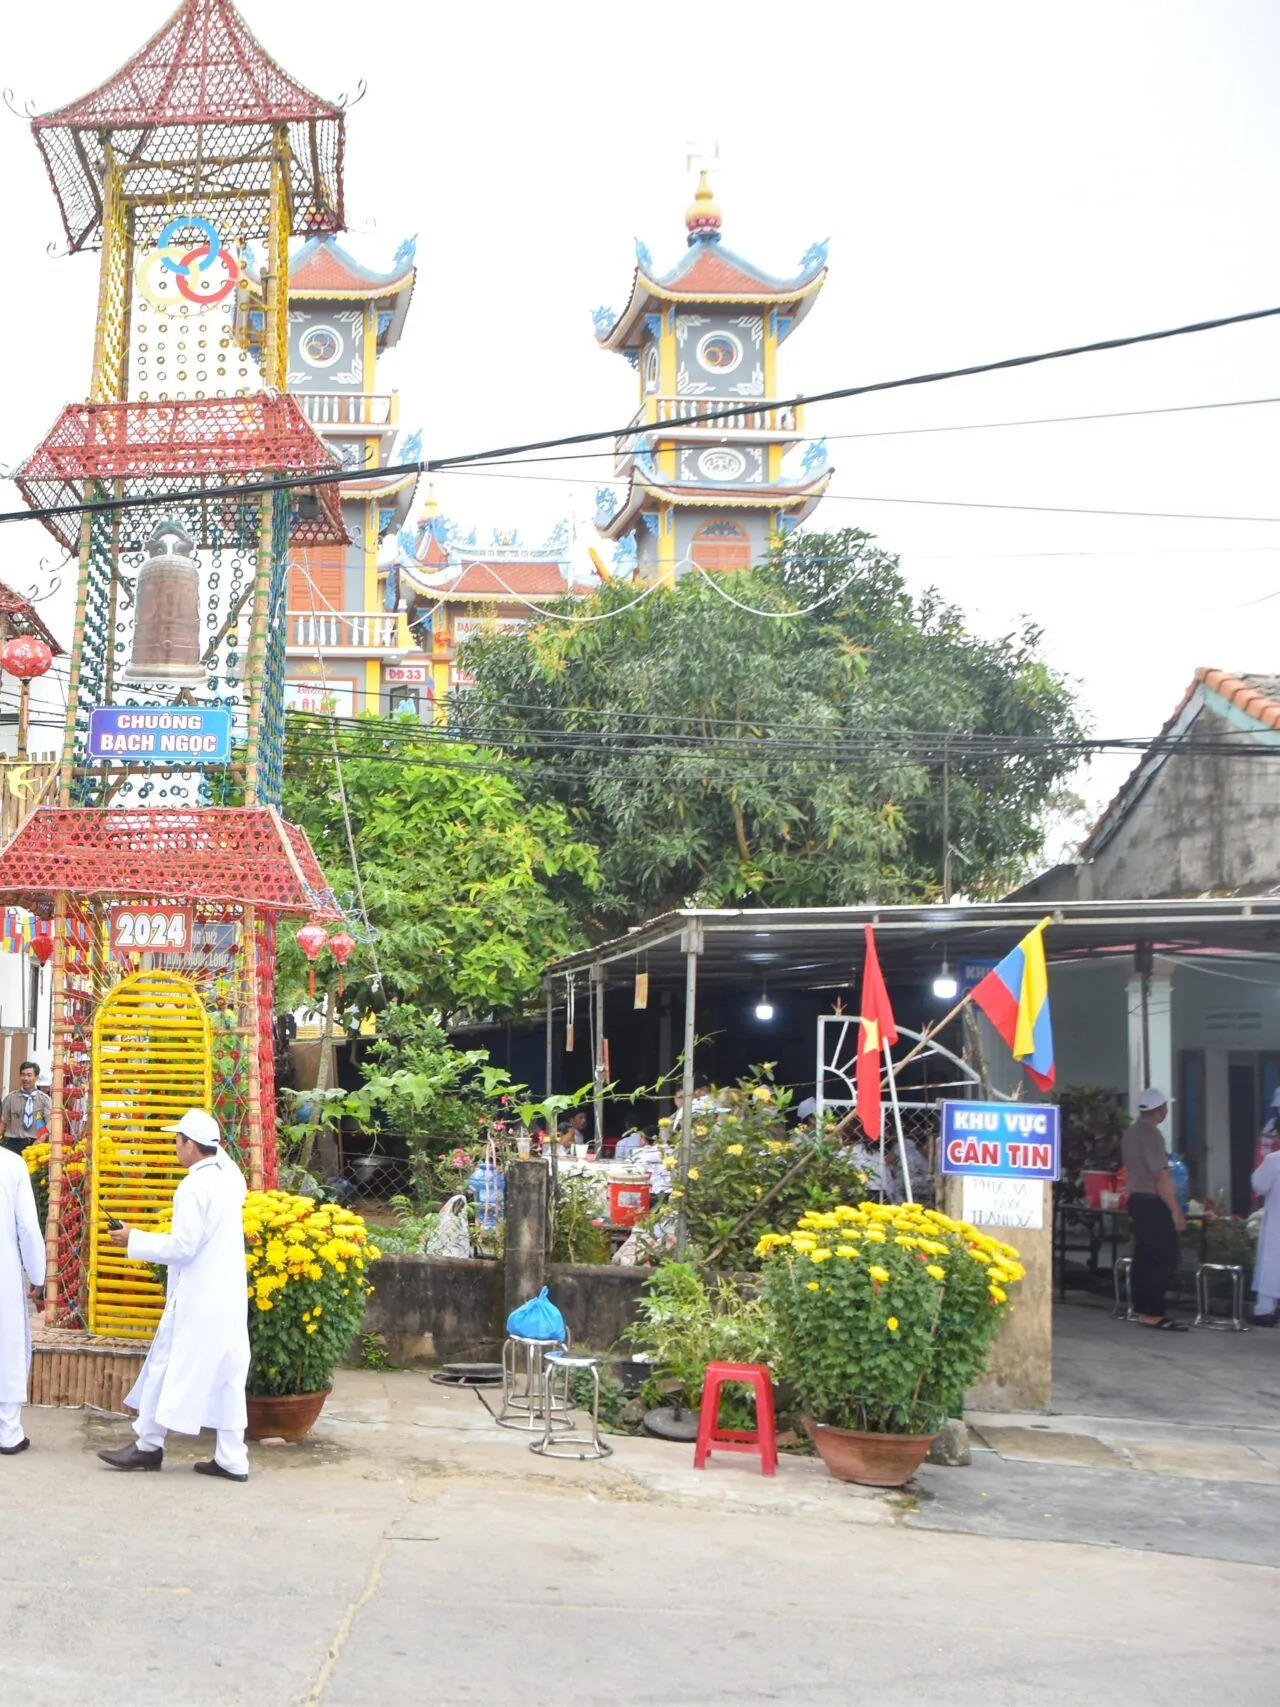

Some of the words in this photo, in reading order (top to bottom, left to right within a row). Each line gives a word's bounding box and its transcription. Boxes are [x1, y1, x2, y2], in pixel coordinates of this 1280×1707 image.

[406, 669, 421, 680] 33
[117, 712, 202, 730] CHUÔNG
[100, 734, 154, 754] BẠCH
[160, 734, 217, 756] NGỌC
[116, 912, 186, 947] 2024
[965, 966, 989, 979] KH
[953, 1110, 998, 1131] KHU
[1004, 1112, 1047, 1138] VỰC
[1006, 1143, 1052, 1170] TIN
